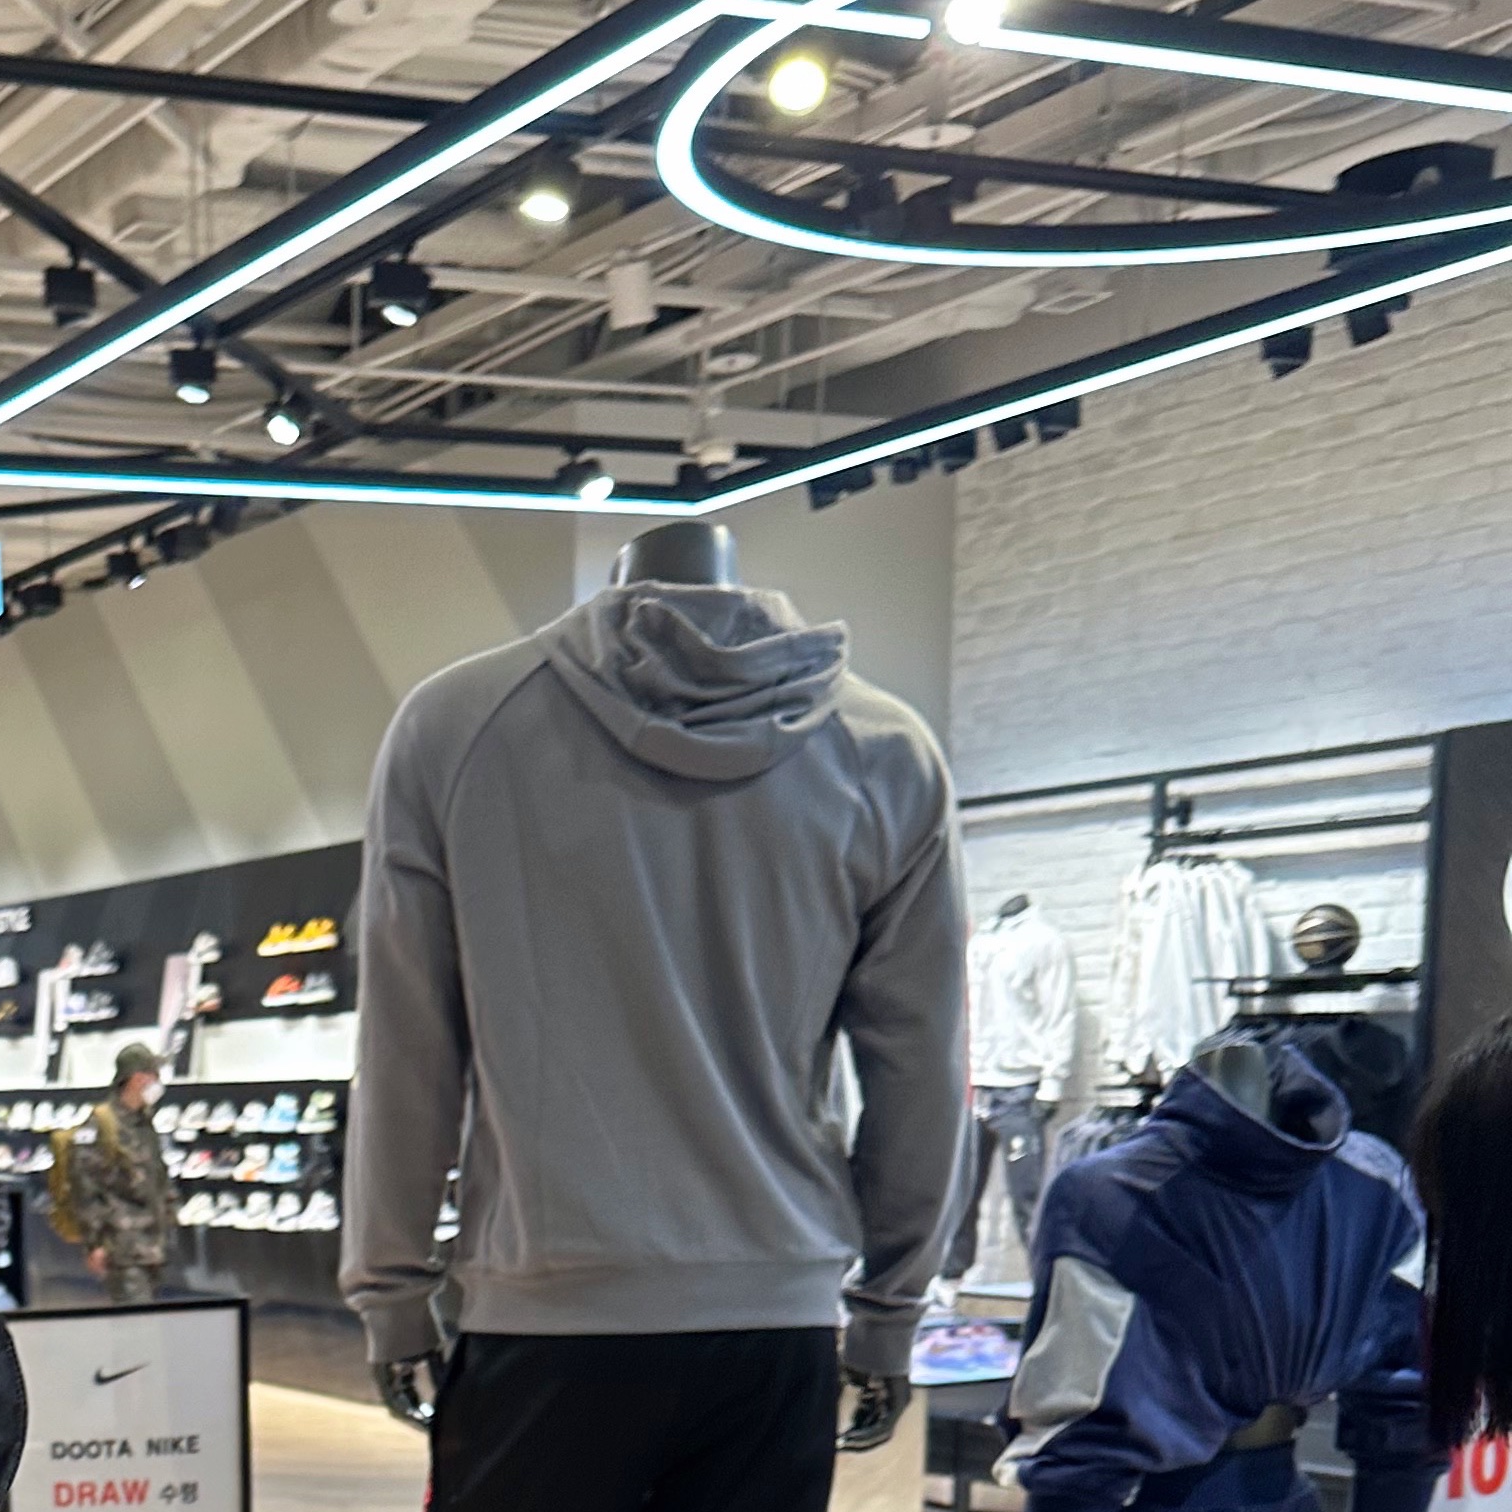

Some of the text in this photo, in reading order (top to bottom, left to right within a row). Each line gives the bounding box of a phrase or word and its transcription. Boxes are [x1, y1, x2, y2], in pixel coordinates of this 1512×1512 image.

[51, 1434, 200, 1460] DOOTA NIKE
[53, 1479, 150, 1508] DRAW
